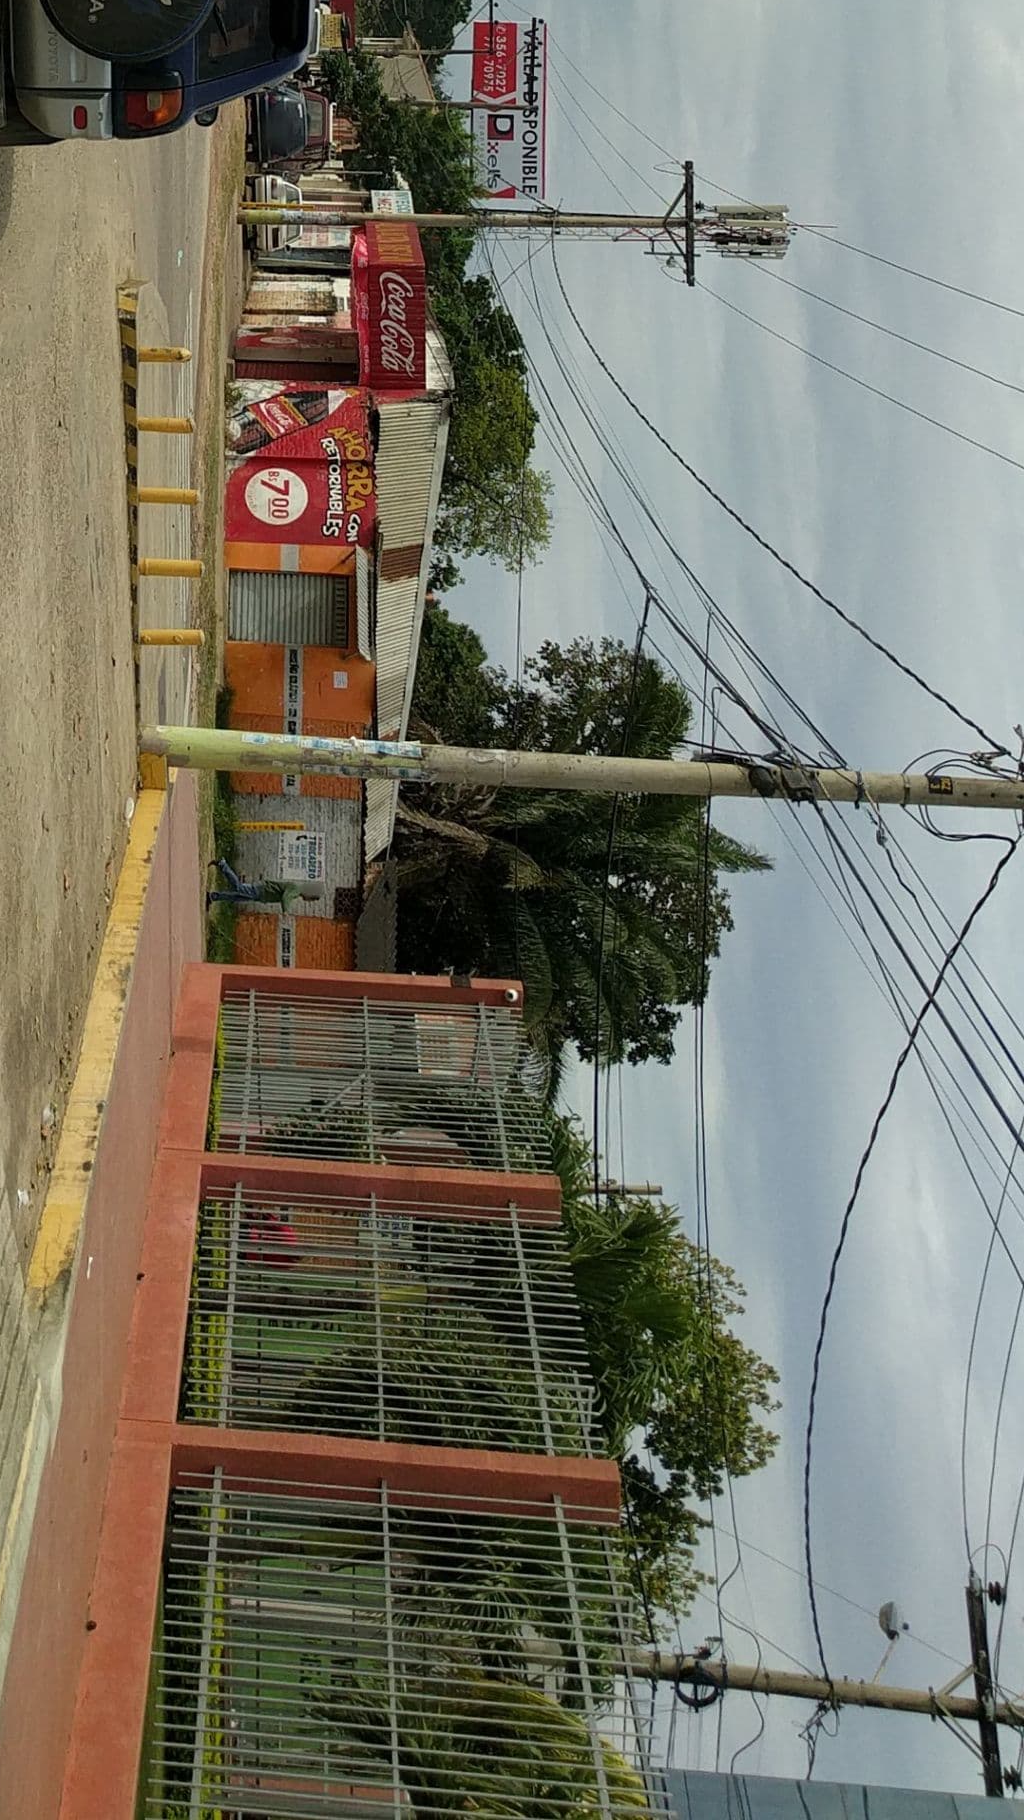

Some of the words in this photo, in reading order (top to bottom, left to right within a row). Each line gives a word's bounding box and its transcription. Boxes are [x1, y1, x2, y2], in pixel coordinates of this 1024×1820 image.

[522, 91, 539, 194] DSPONIBLE
[379, 271, 416, 378] Coca-Cola
[320, 437, 344, 537] RETORNABLES
[327, 426, 373, 512] AHORRA
[346, 513, 361, 542] CON
